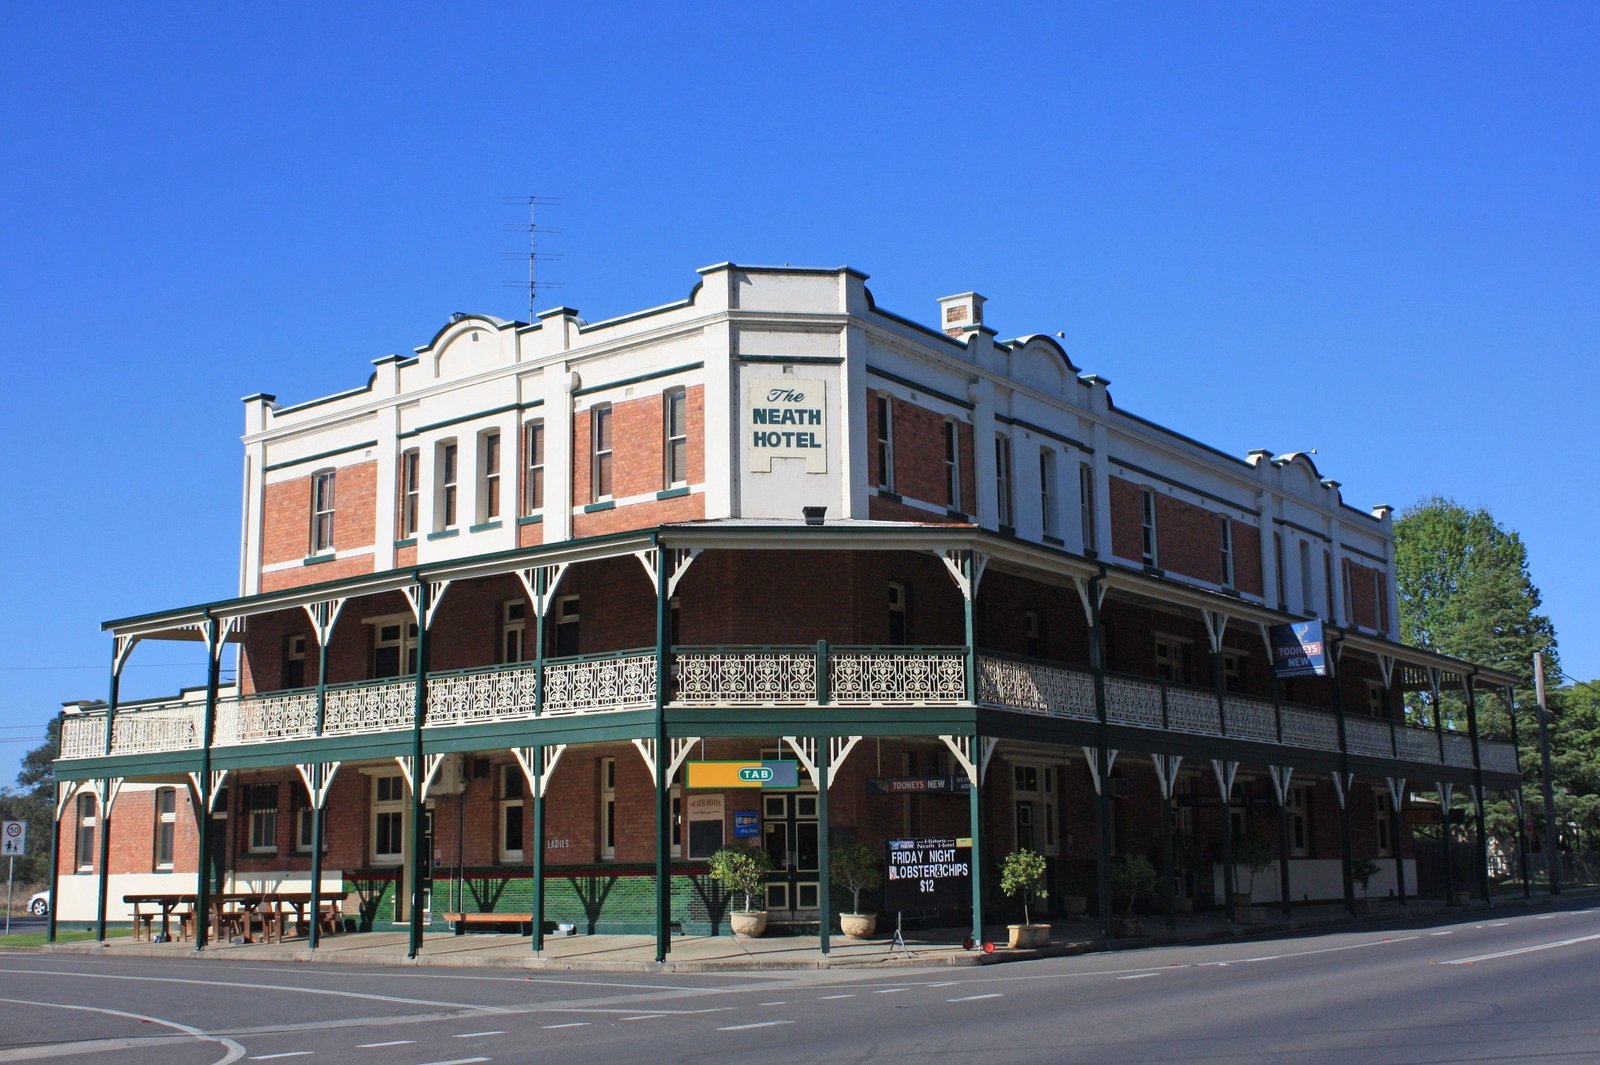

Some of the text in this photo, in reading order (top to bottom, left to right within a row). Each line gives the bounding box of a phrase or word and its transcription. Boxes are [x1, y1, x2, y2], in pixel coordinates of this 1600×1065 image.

[766, 388, 806, 403] The
[753, 408, 821, 425] NEATH
[753, 431, 822, 448] HOTEL
[1279, 644, 1317, 656] TOOHEYS
[1288, 656, 1309, 668] NEW
[743, 770, 769, 779] TAB
[893, 779, 945, 789] TOOHEYS NEW
[9, 826, 19, 834] 50
[547, 839, 569, 849] LADIES
[891, 849, 956, 864] FRIDAY NIGHT
[920, 880, 934, 892] $12
